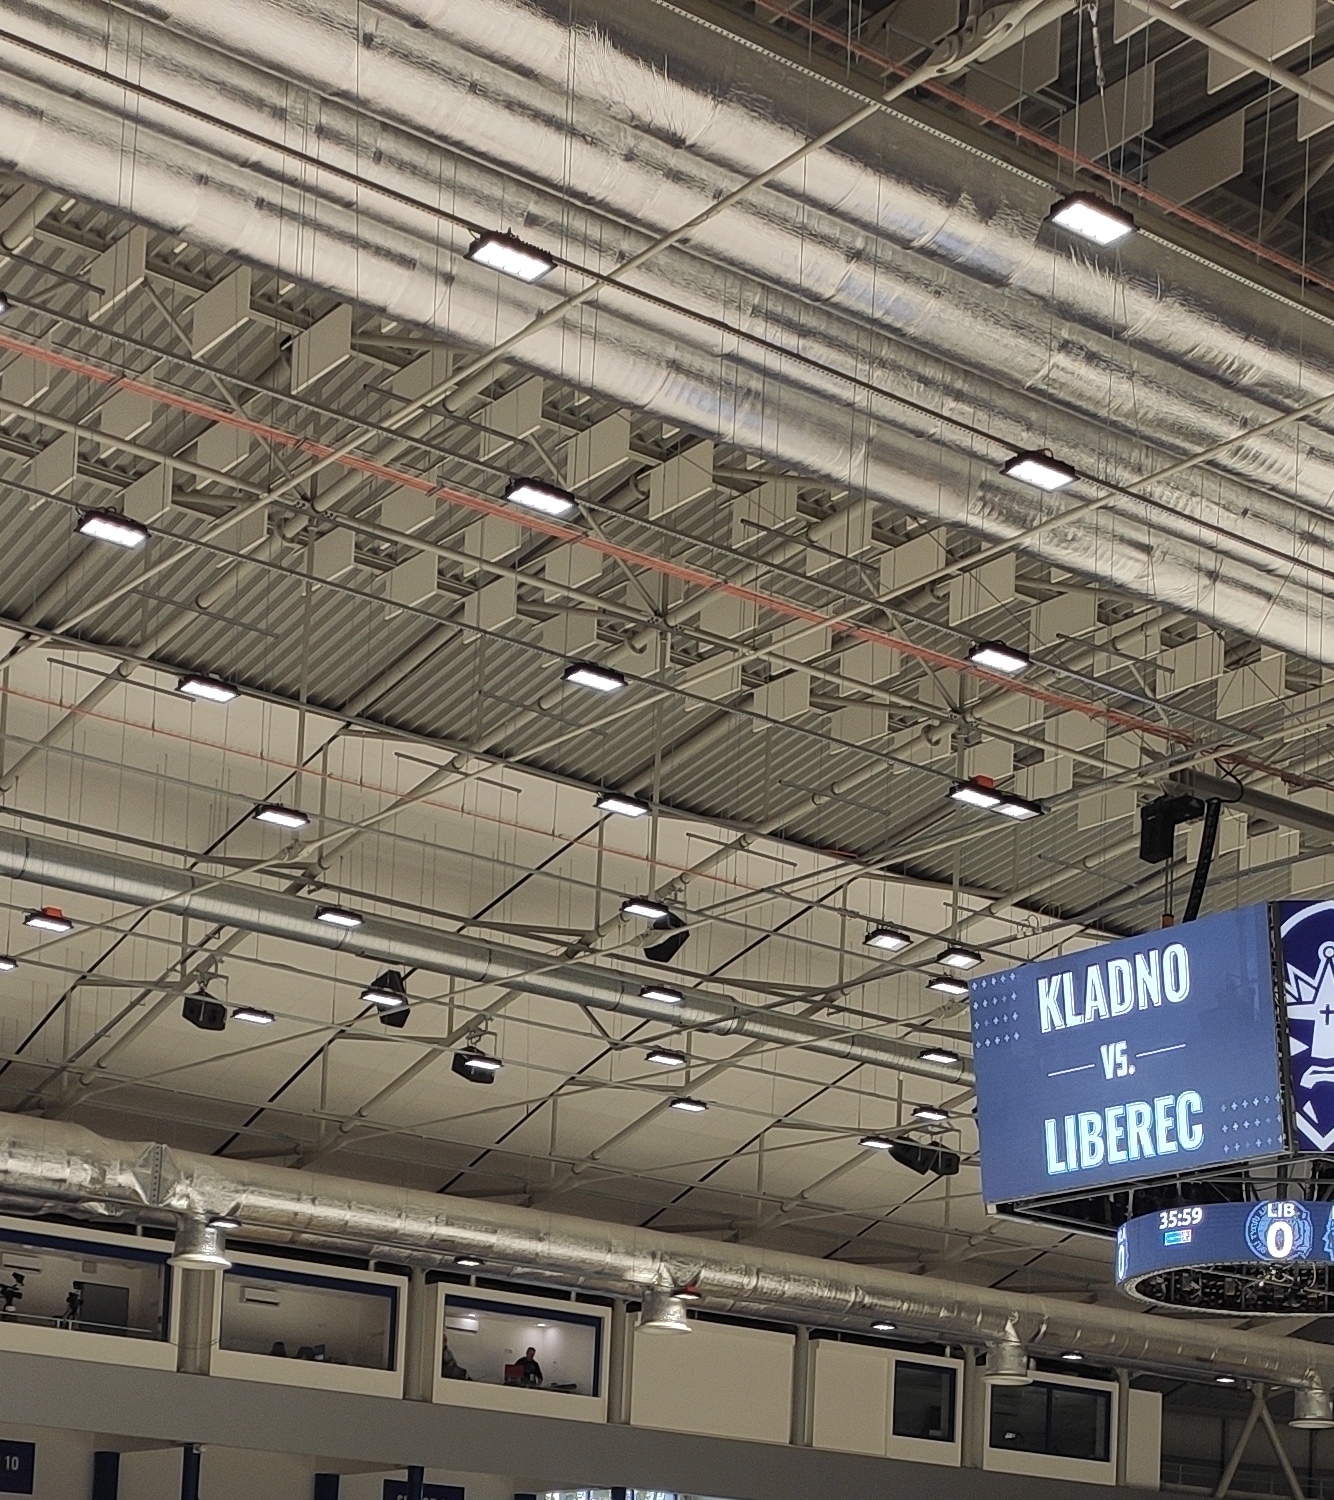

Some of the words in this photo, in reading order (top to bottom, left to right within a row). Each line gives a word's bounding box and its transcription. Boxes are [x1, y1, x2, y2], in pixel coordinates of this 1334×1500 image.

[1036, 941, 1191, 1034] KLADNO
[1100, 1041, 1136, 1080] VS.
[1043, 1090, 1205, 1176] LIBEREC
[1159, 1207, 1203, 1230] 35:59
[1267, 1203, 1296, 1218] LIB
[1266, 1221, 1293, 1258] 0
[5, 1455, 20, 1471] 10
